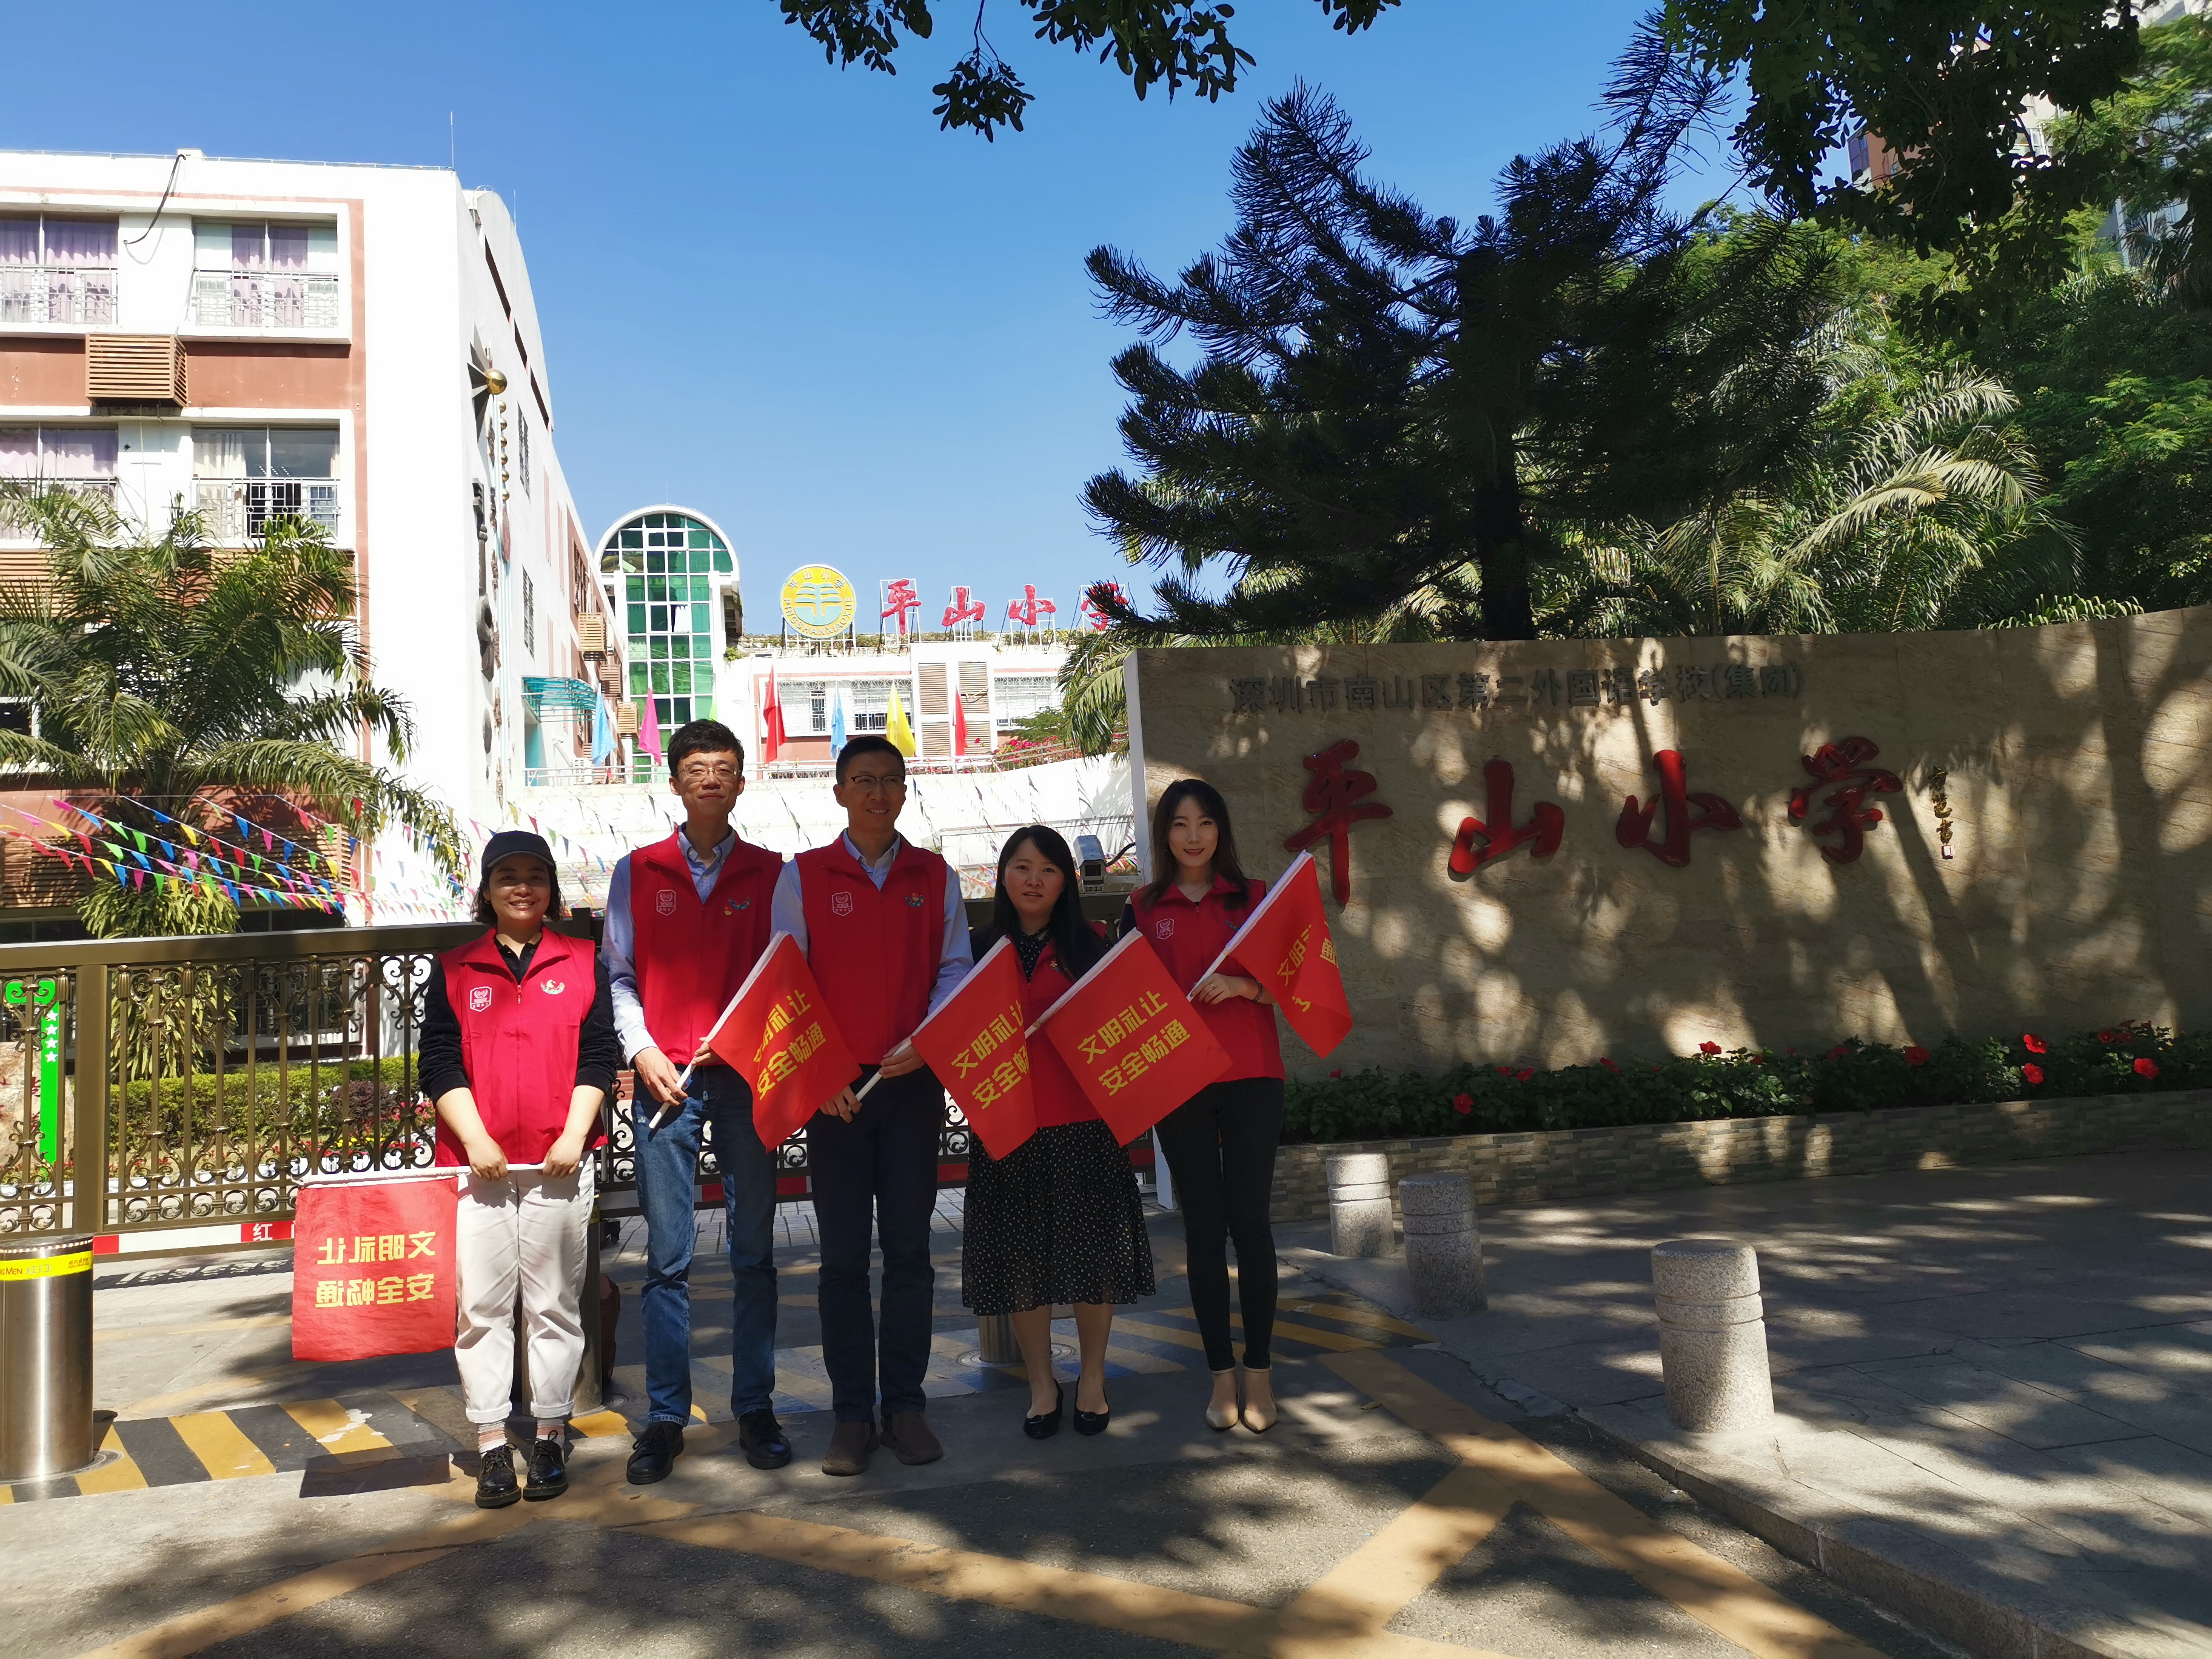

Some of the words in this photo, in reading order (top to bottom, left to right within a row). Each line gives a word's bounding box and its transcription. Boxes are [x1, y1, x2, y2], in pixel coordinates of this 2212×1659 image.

[783, 596, 853, 635] PINGSHANXIAOXUE
[788, 570, 845, 589] 平山小学
[1284, 736, 1903, 907] 平山小学
[757, 1021, 826, 1101] 安全畅通
[1077, 990, 1168, 1064] 文明礼让
[1098, 1019, 1191, 1096] 安全畅通
